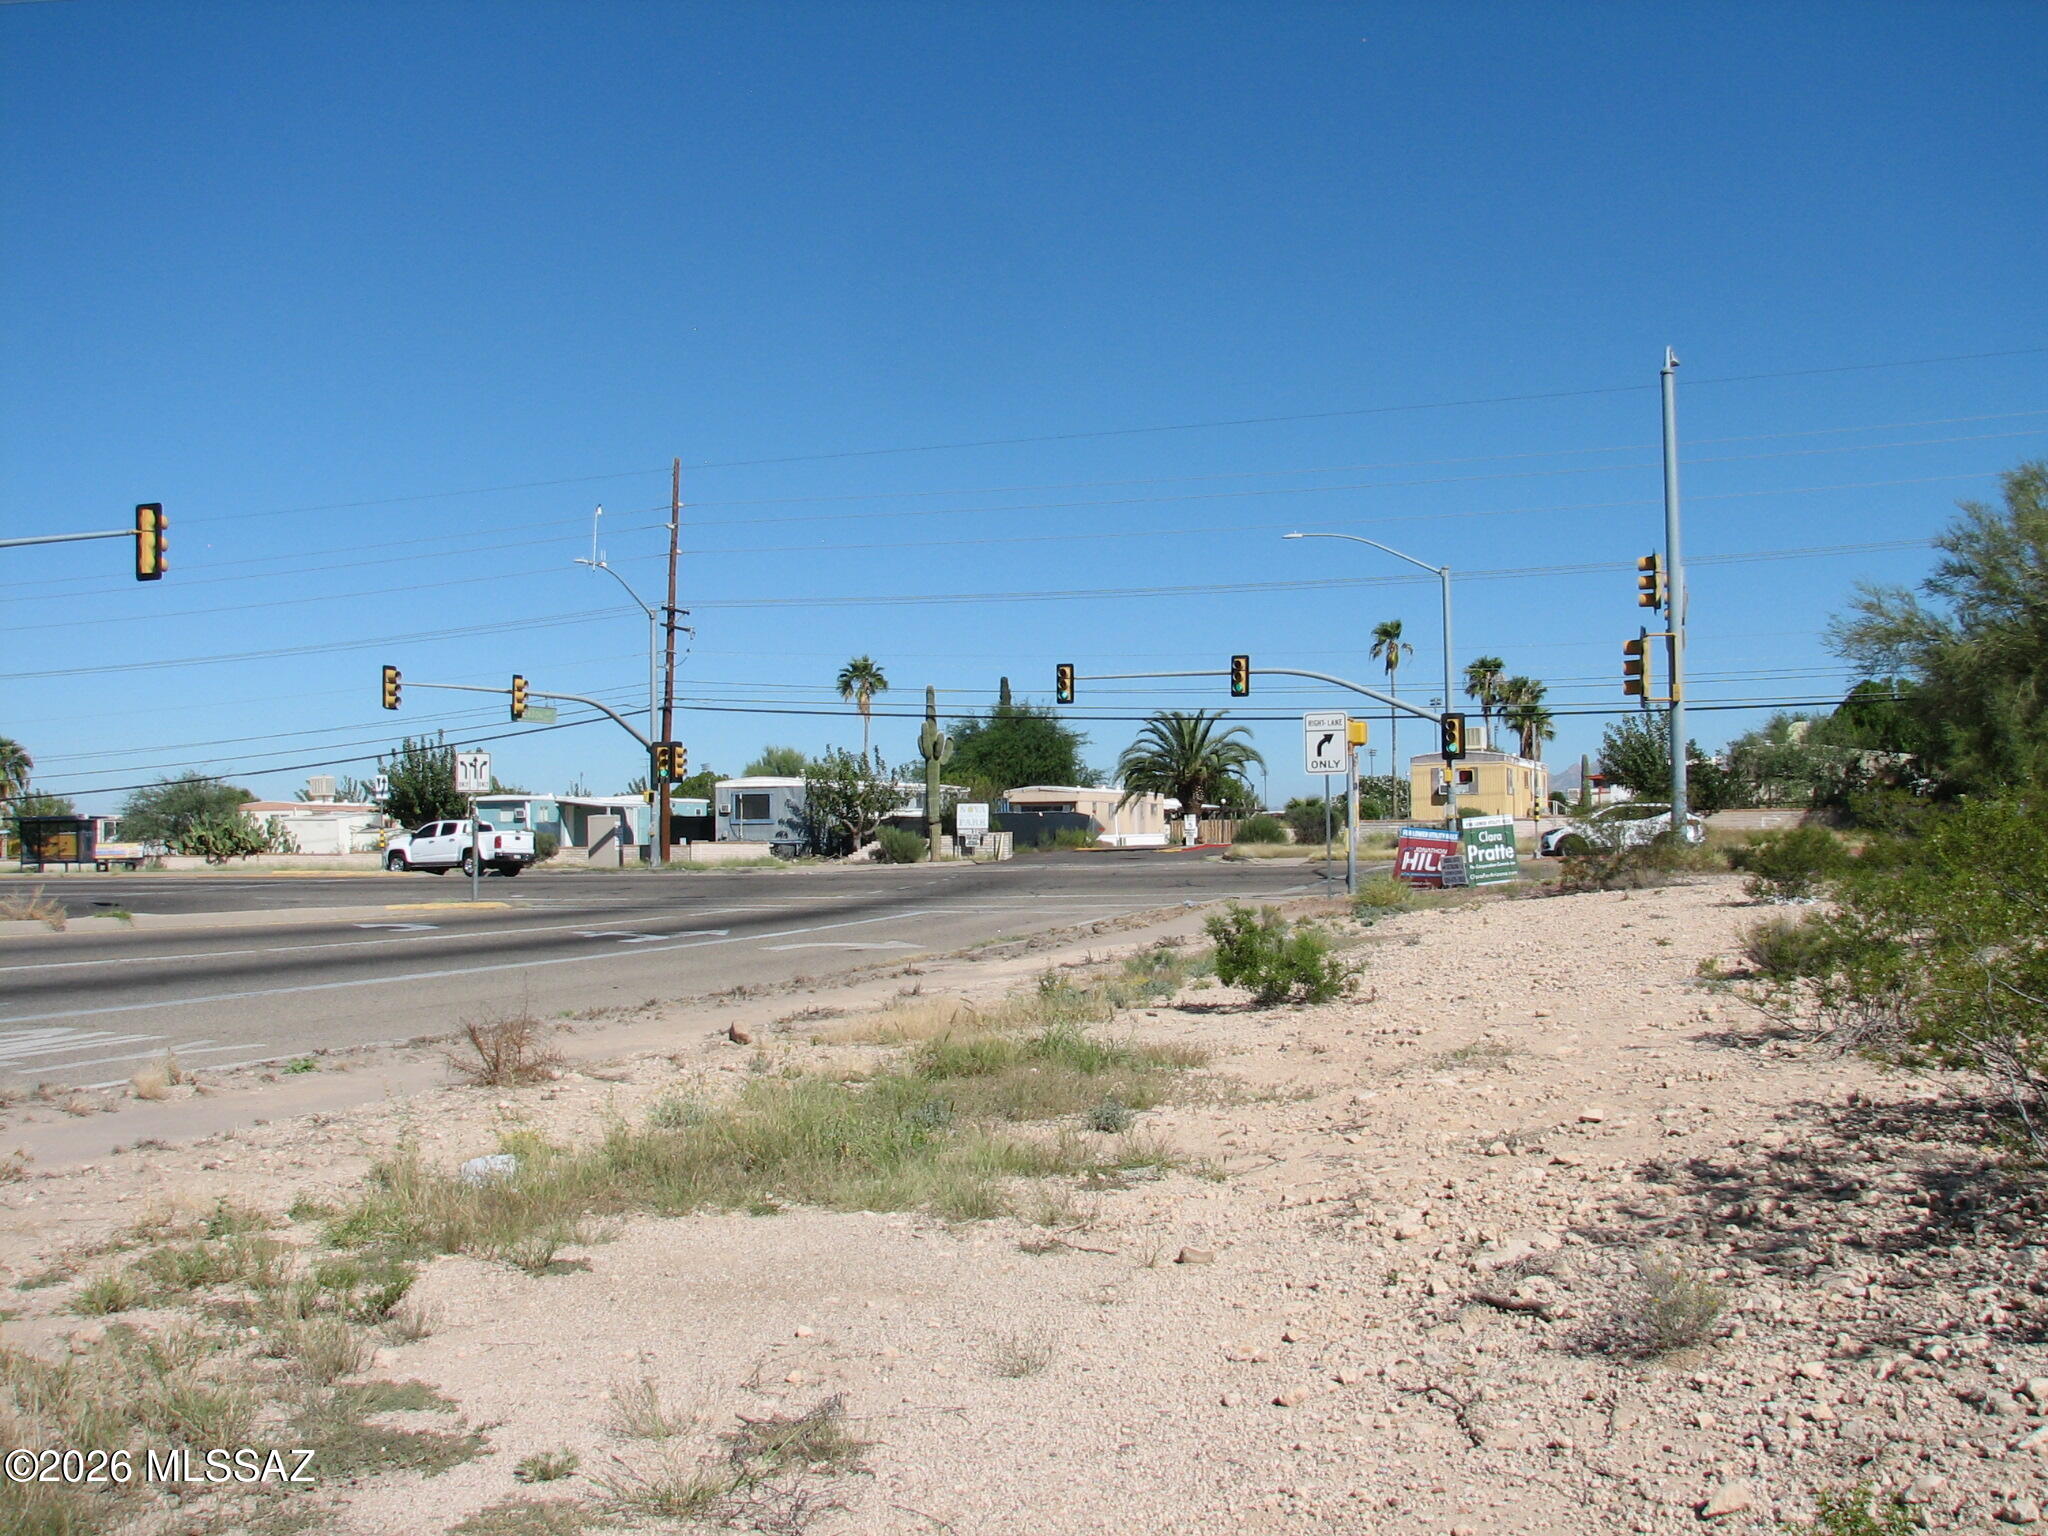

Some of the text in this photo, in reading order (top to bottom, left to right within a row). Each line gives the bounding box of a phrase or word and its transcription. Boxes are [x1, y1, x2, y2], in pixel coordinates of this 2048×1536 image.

[1311, 759, 1341, 769] ONLY
[1478, 830, 1503, 843] Clara
[1467, 843, 1515, 863] Pratte
